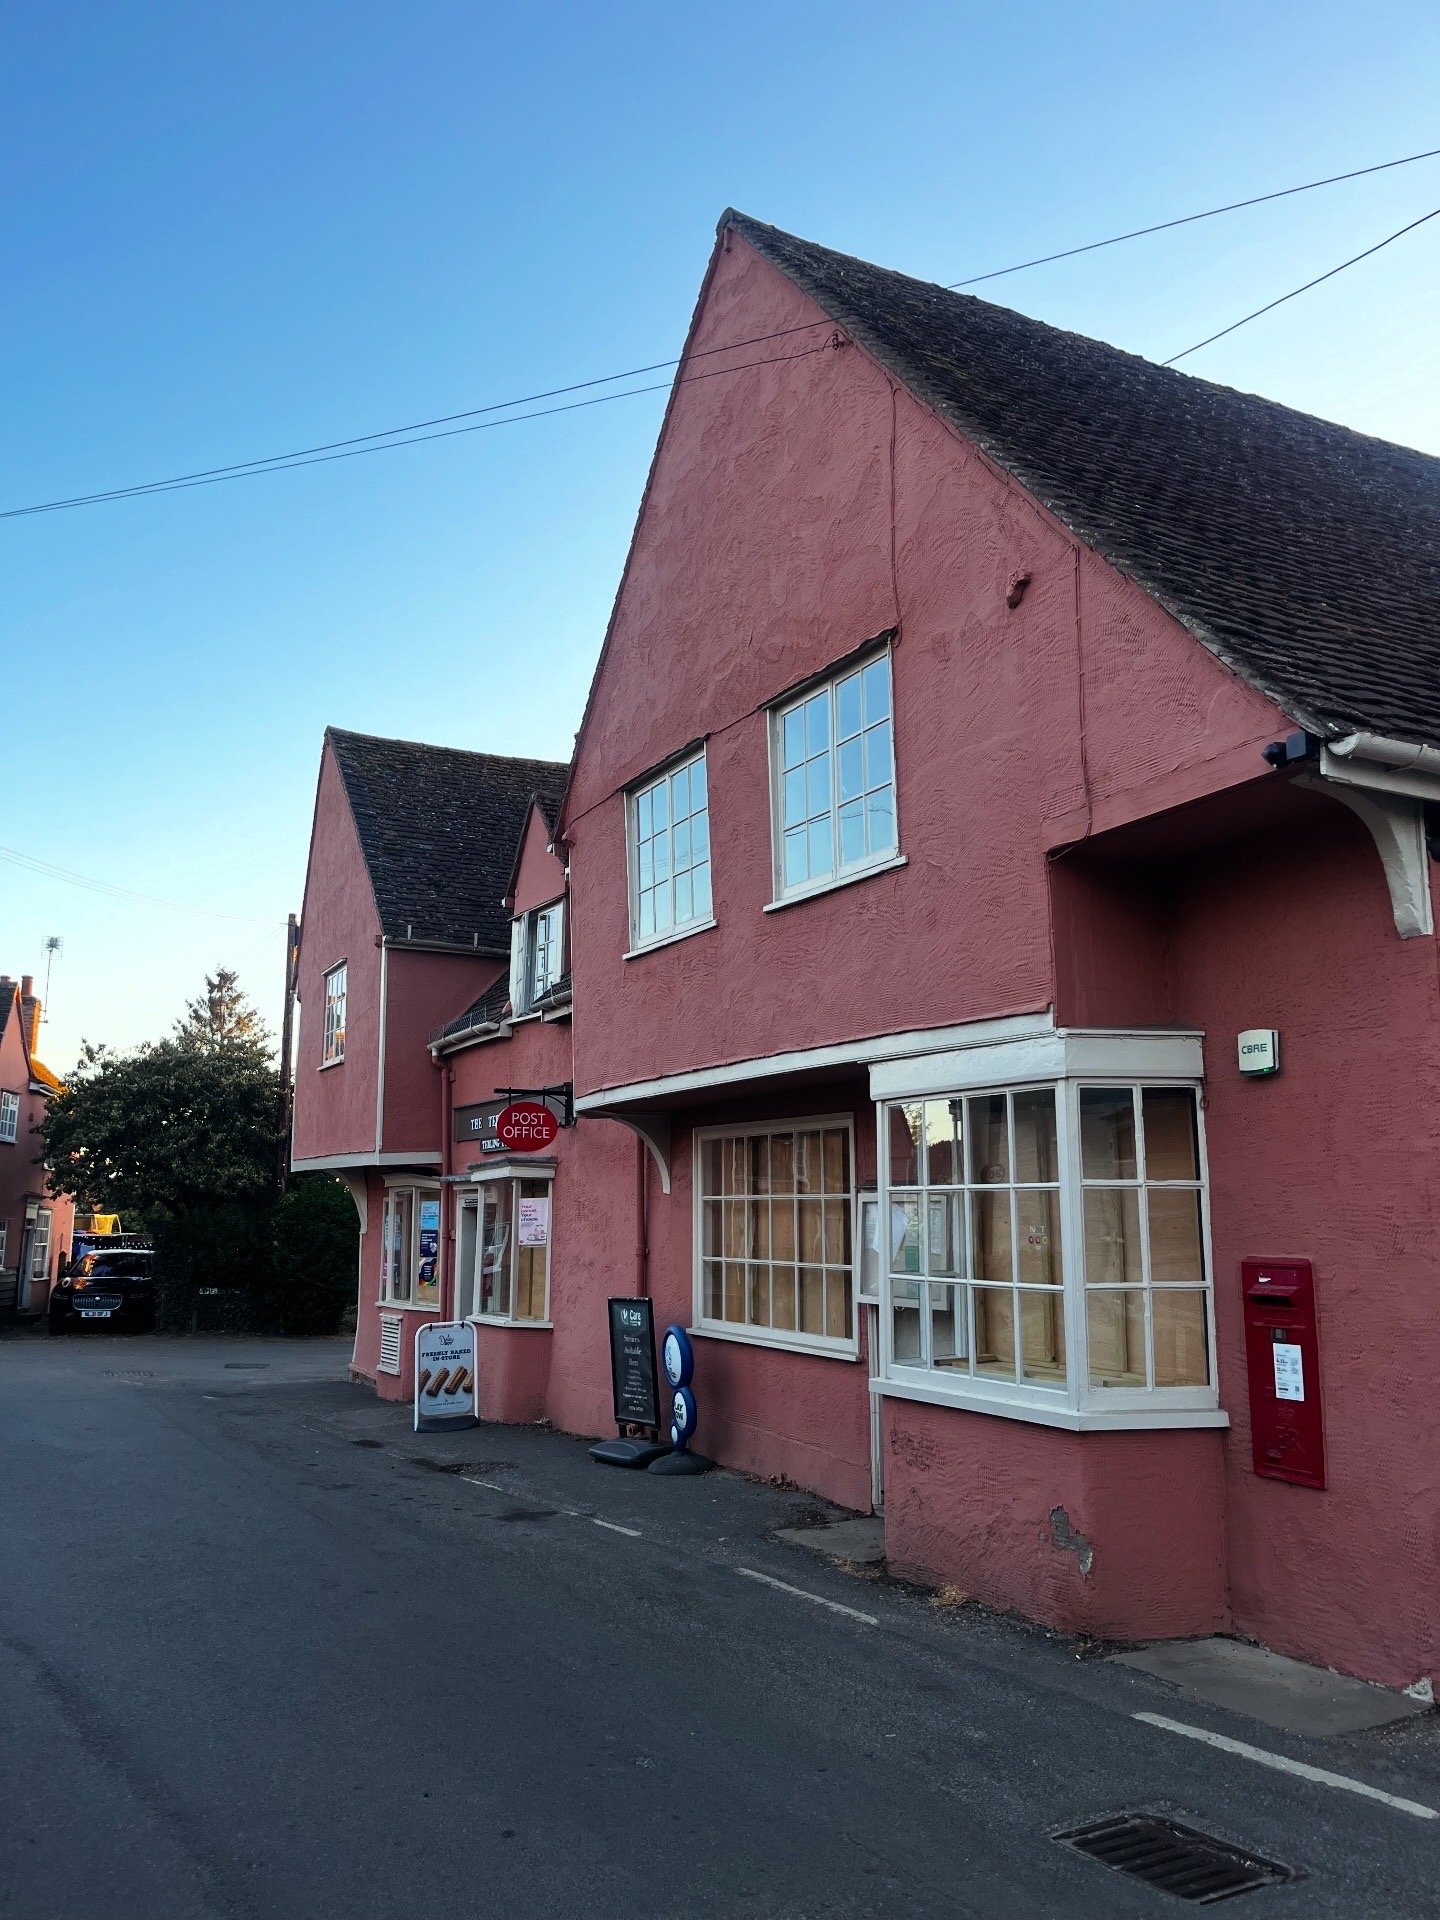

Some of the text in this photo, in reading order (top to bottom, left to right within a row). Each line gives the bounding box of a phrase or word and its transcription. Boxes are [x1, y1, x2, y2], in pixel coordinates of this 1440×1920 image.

[1241, 1043, 1268, 1055] CBRE
[470, 1117, 483, 1131] THE
[511, 1112, 546, 1124] POST
[503, 1126, 550, 1138] OFFICE
[629, 1309, 642, 1321] Care
